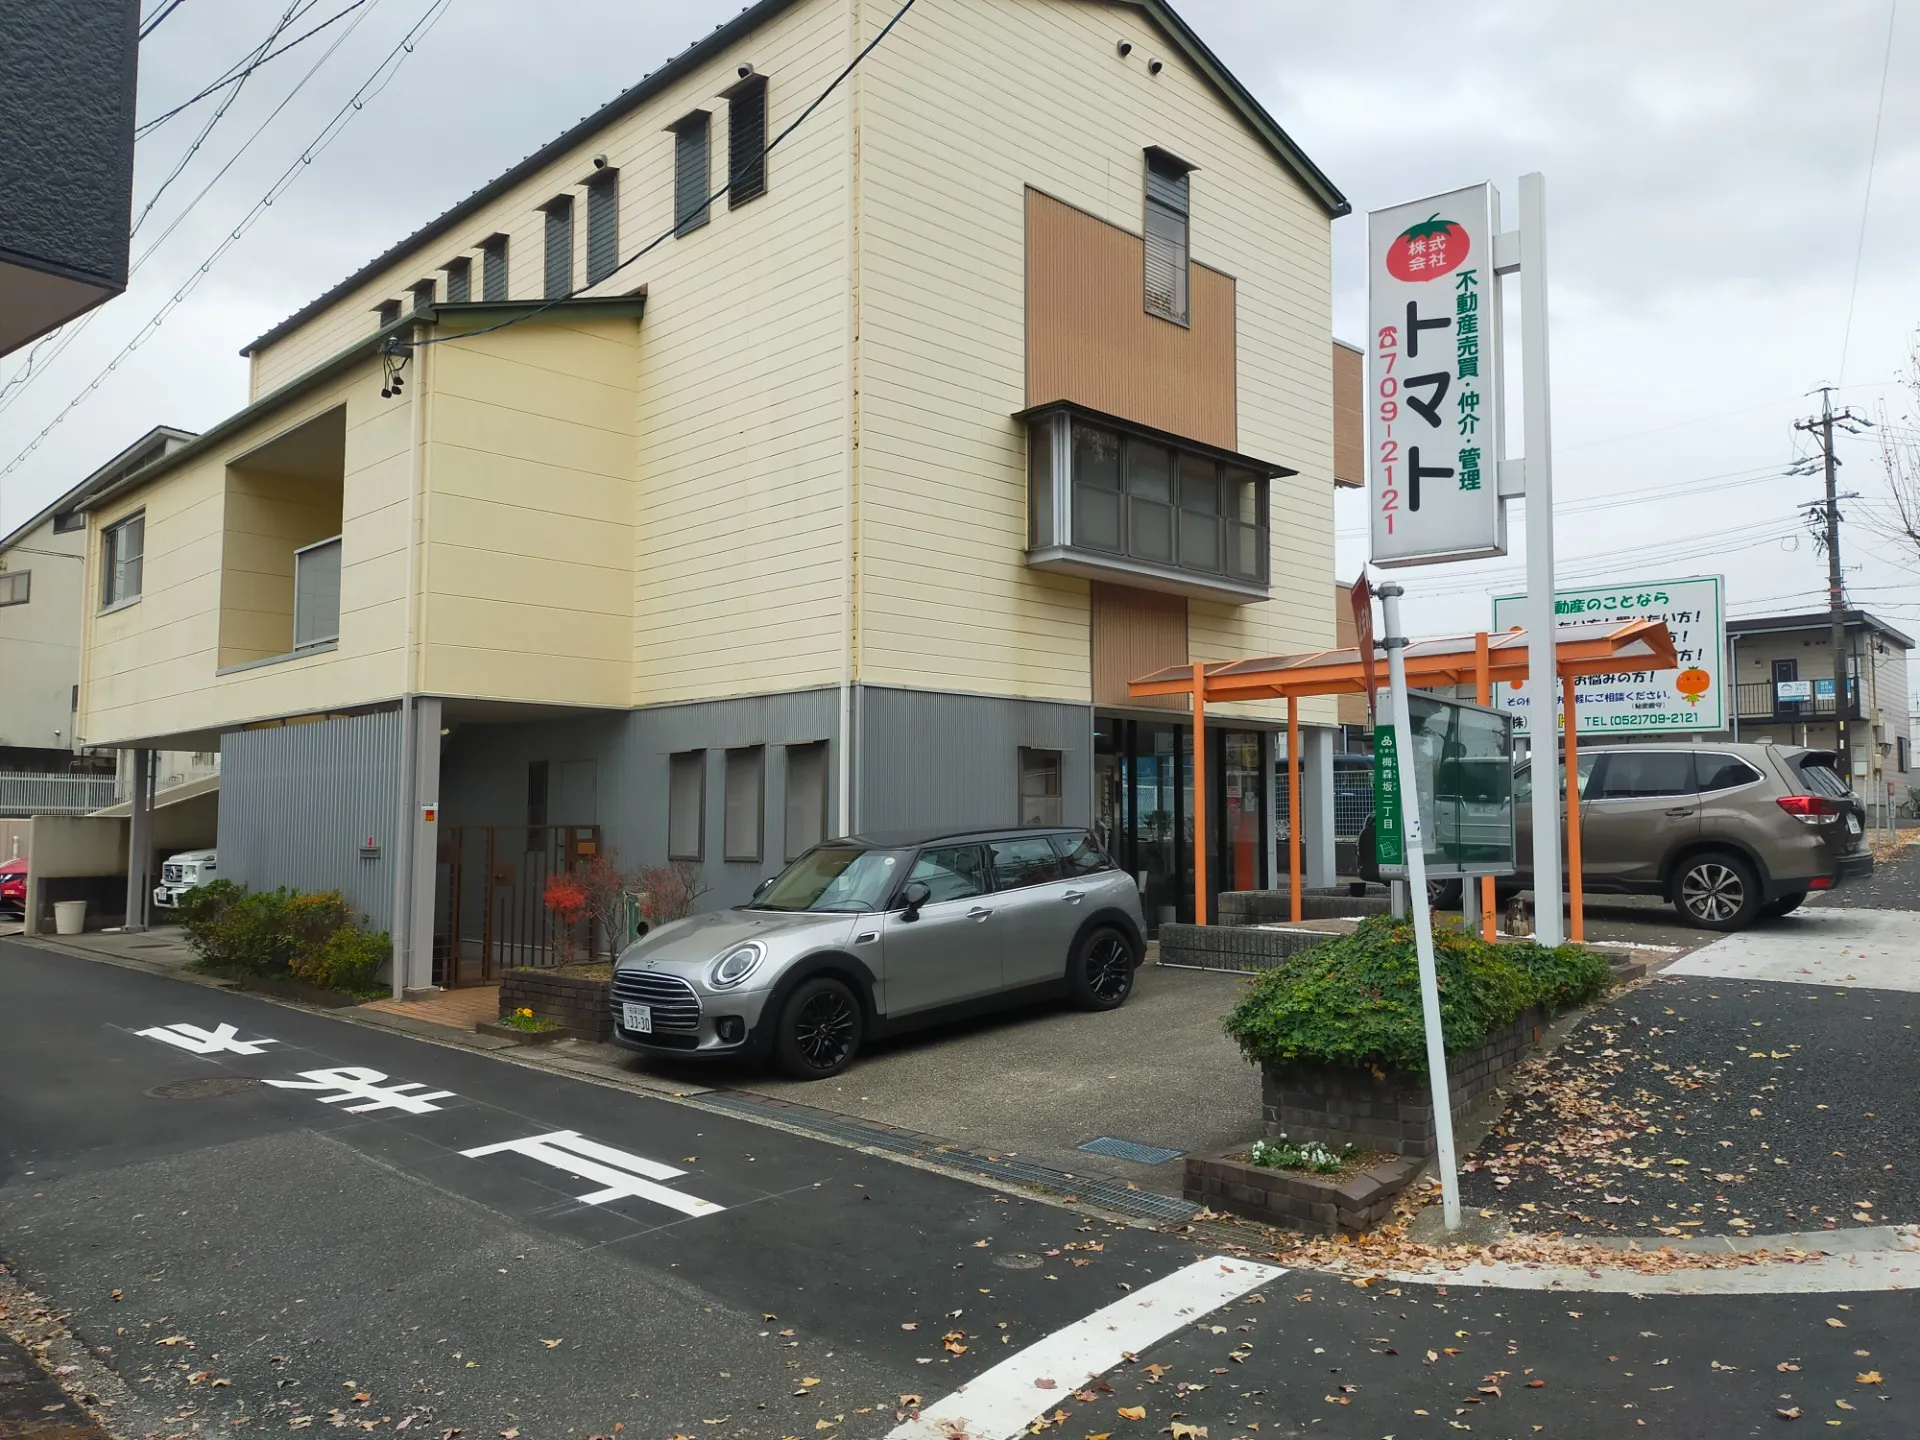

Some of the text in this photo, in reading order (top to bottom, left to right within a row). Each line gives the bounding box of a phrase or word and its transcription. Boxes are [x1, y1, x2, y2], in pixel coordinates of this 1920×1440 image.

[1408, 235, 1447, 257] 株式
[1408, 251, 1447, 272] 会社
[1455, 268, 1481, 492] 不動産売買・仲介・管理
[1402, 300, 1455, 512] トマト
[1584, 715, 1608, 727] TEL
